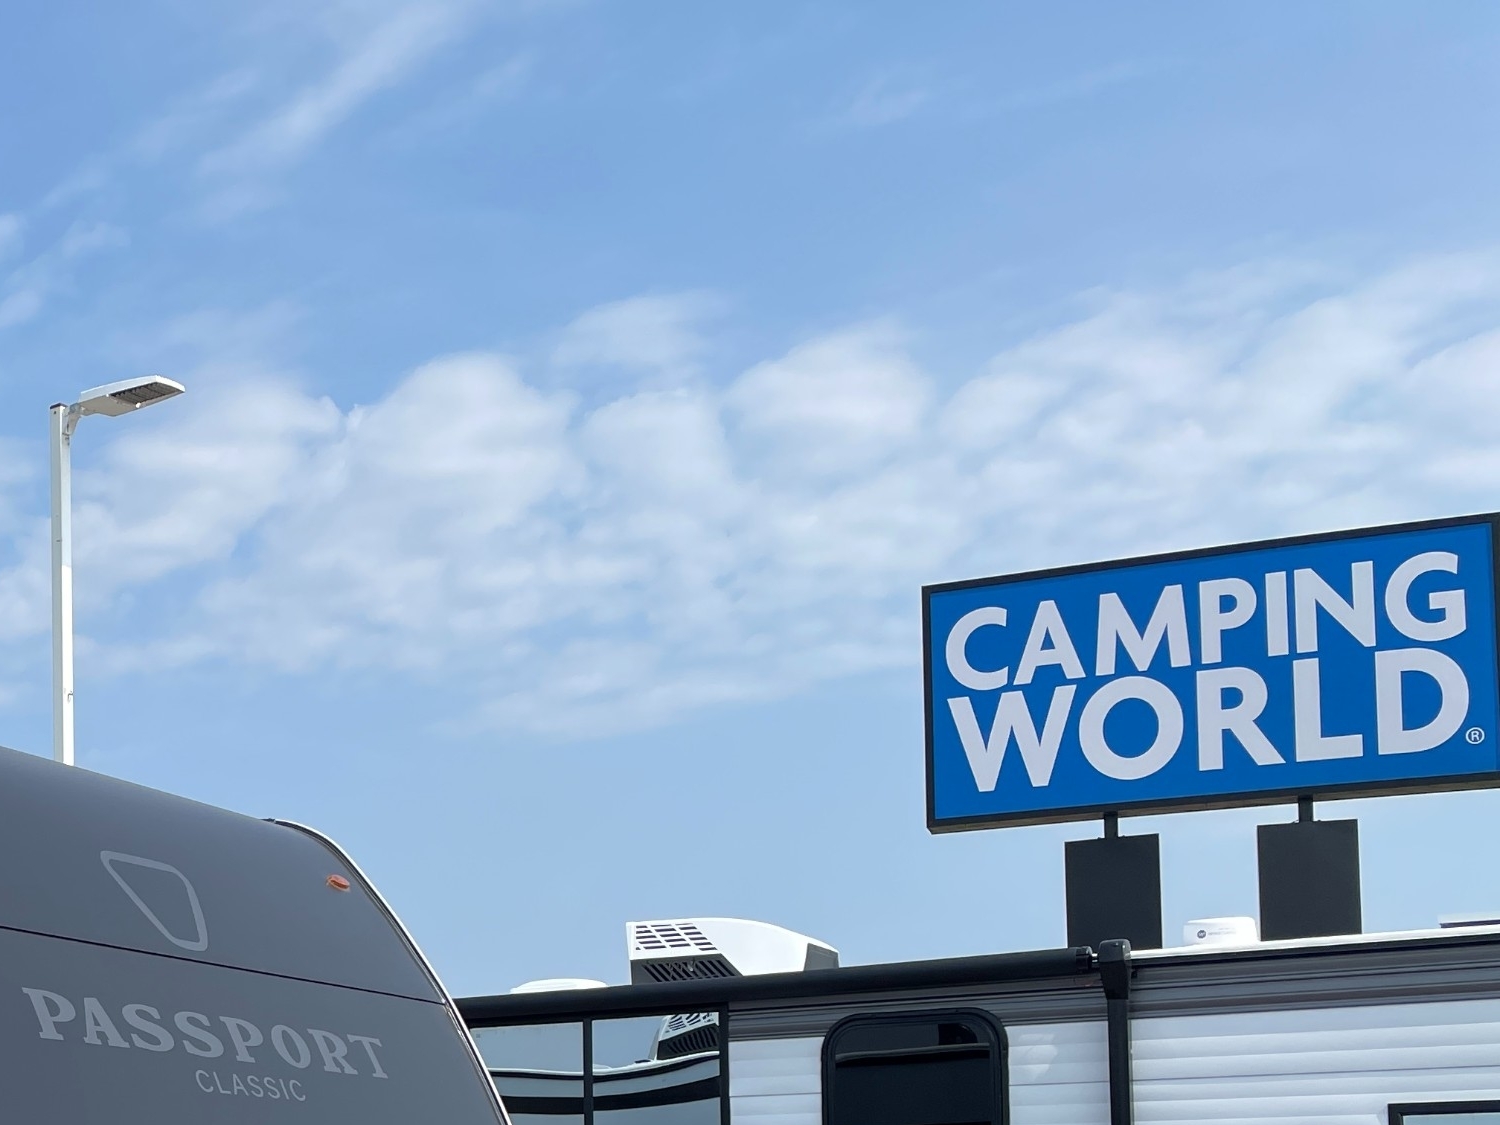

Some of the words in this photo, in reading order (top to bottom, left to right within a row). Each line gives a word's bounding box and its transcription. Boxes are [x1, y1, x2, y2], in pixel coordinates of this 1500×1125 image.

[945, 551, 1467, 691] CAMPING
[947, 647, 1470, 792] WORLD
[21, 986, 389, 1079] PASSPORT
[195, 1069, 306, 1101] CLASSIC
